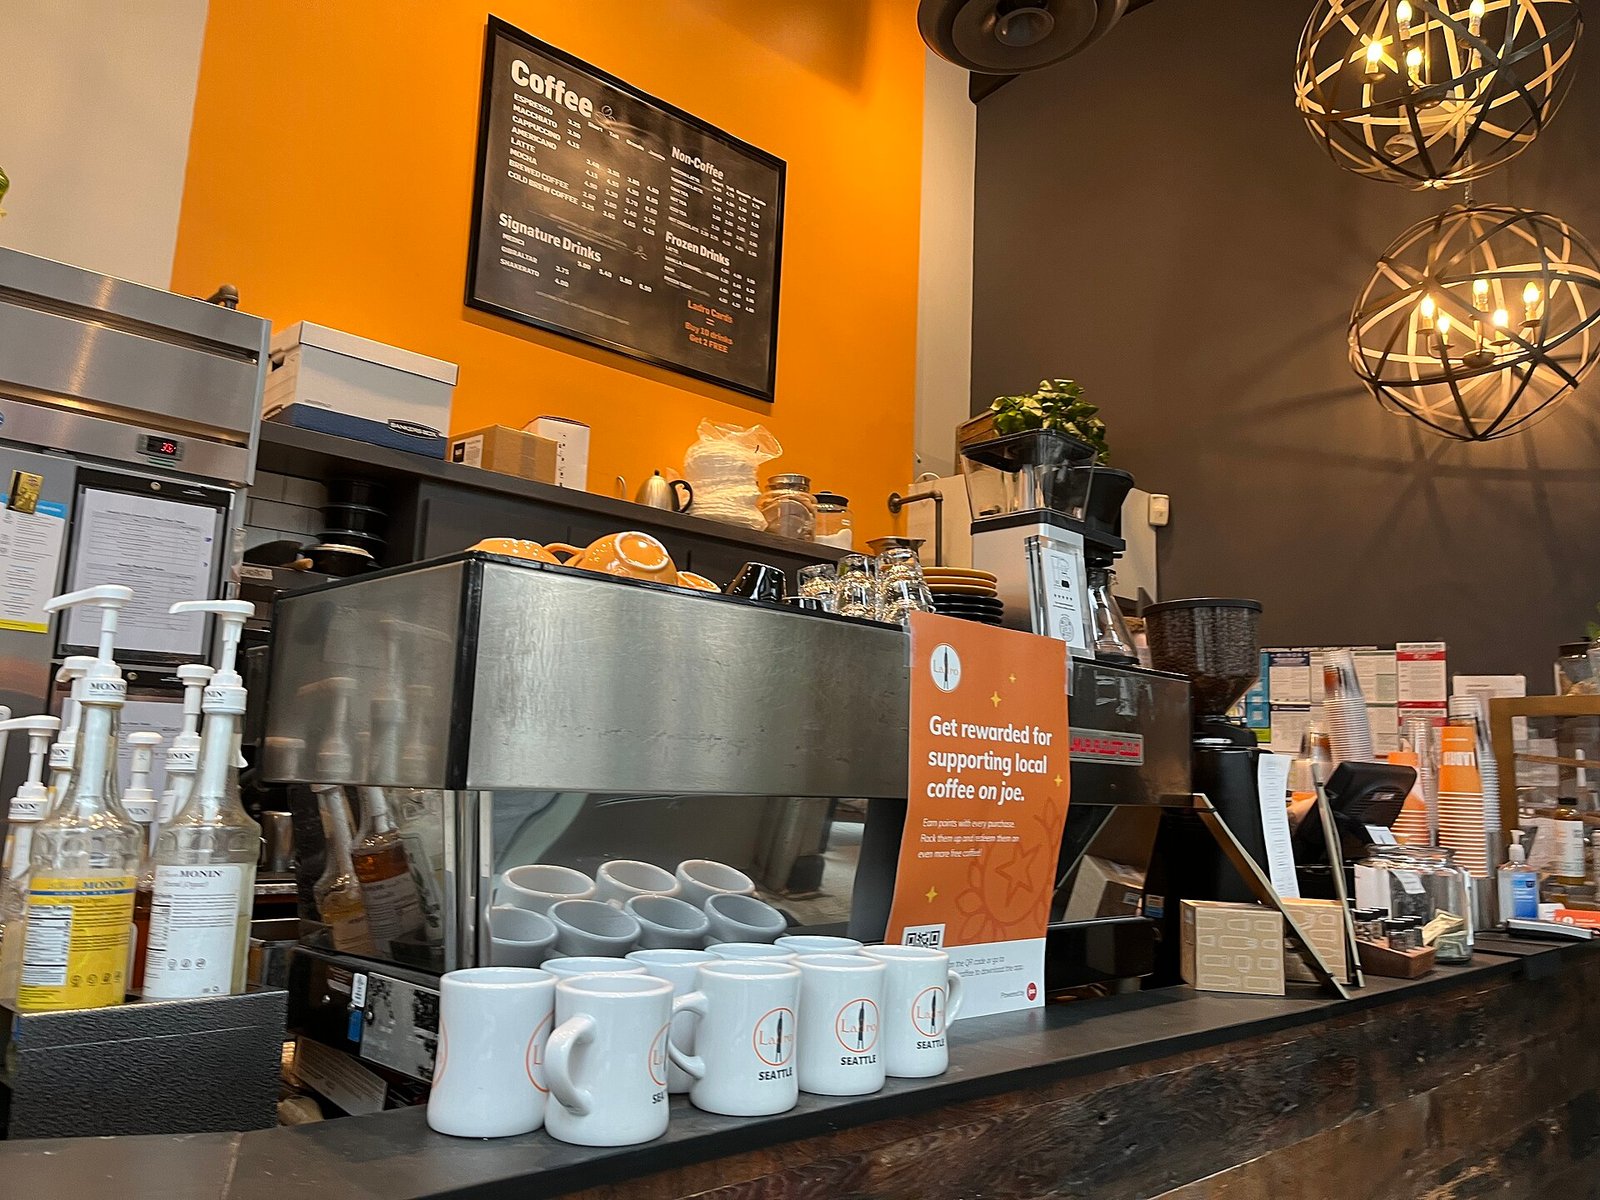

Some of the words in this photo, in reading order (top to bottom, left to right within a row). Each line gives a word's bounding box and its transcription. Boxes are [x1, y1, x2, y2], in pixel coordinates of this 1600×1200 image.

[511, 60, 593, 118] Coffee
[514, 93, 553, 115] ESPRESSO
[513, 104, 558, 128] MACCHIATO
[511, 126, 557, 150] AMERICANO
[512, 115, 561, 141] CAPPUCCINO
[511, 137, 536, 153] LATTE
[510, 148, 538, 165] MOCHA
[671, 146, 724, 180] Non-Coffee
[509, 159, 541, 178] BREWED
[540, 173, 569, 190] COFFEE
[508, 170, 528, 184] COLD
[528, 179, 550, 193] BREW
[550, 188, 579, 205] COFFEE
[499, 213, 561, 247] Signature
[562, 237, 601, 262] Drinks
[501, 246, 538, 264] GIBRALTAR
[665, 231, 699, 254] Frozen
[700, 245, 730, 266] Drinks
[500, 258, 540, 277] SHAKERATO
[711, 309, 733, 323] Cards
[685, 322, 699, 334] Buy
[700, 327, 710, 336] 10
[710, 332, 733, 345] drinks
[689, 334, 702, 344] Get
[703, 338, 708, 346] 2
[708, 340, 728, 353] FREE
[929, 715, 958, 737] Get
[962, 723, 1030, 744] rewarded
[1032, 726, 1052, 746] for
[928, 750, 1012, 776] supporting
[1015, 752, 1047, 774] local
[927, 778, 974, 799] coffee
[979, 784, 997, 800] on
[997, 781, 1025, 806] joe.
[922, 818, 938, 828] Earn
[938, 818, 958, 829] points
[958, 819, 972, 828] with
[972, 820, 987, 829] every
[937, 834, 954, 842] them
[954, 836, 962, 844] up
[962, 834, 974, 842] and
[918, 850, 934, 858] even
[950, 848, 962, 858] free
[83, 881, 125, 889] MONIN
[965, 958, 974, 968] QR
[916, 1038, 945, 1050] SEATTLE
[840, 1054, 877, 1066] SEATTLE
[758, 1067, 793, 1082] SEATTLE
